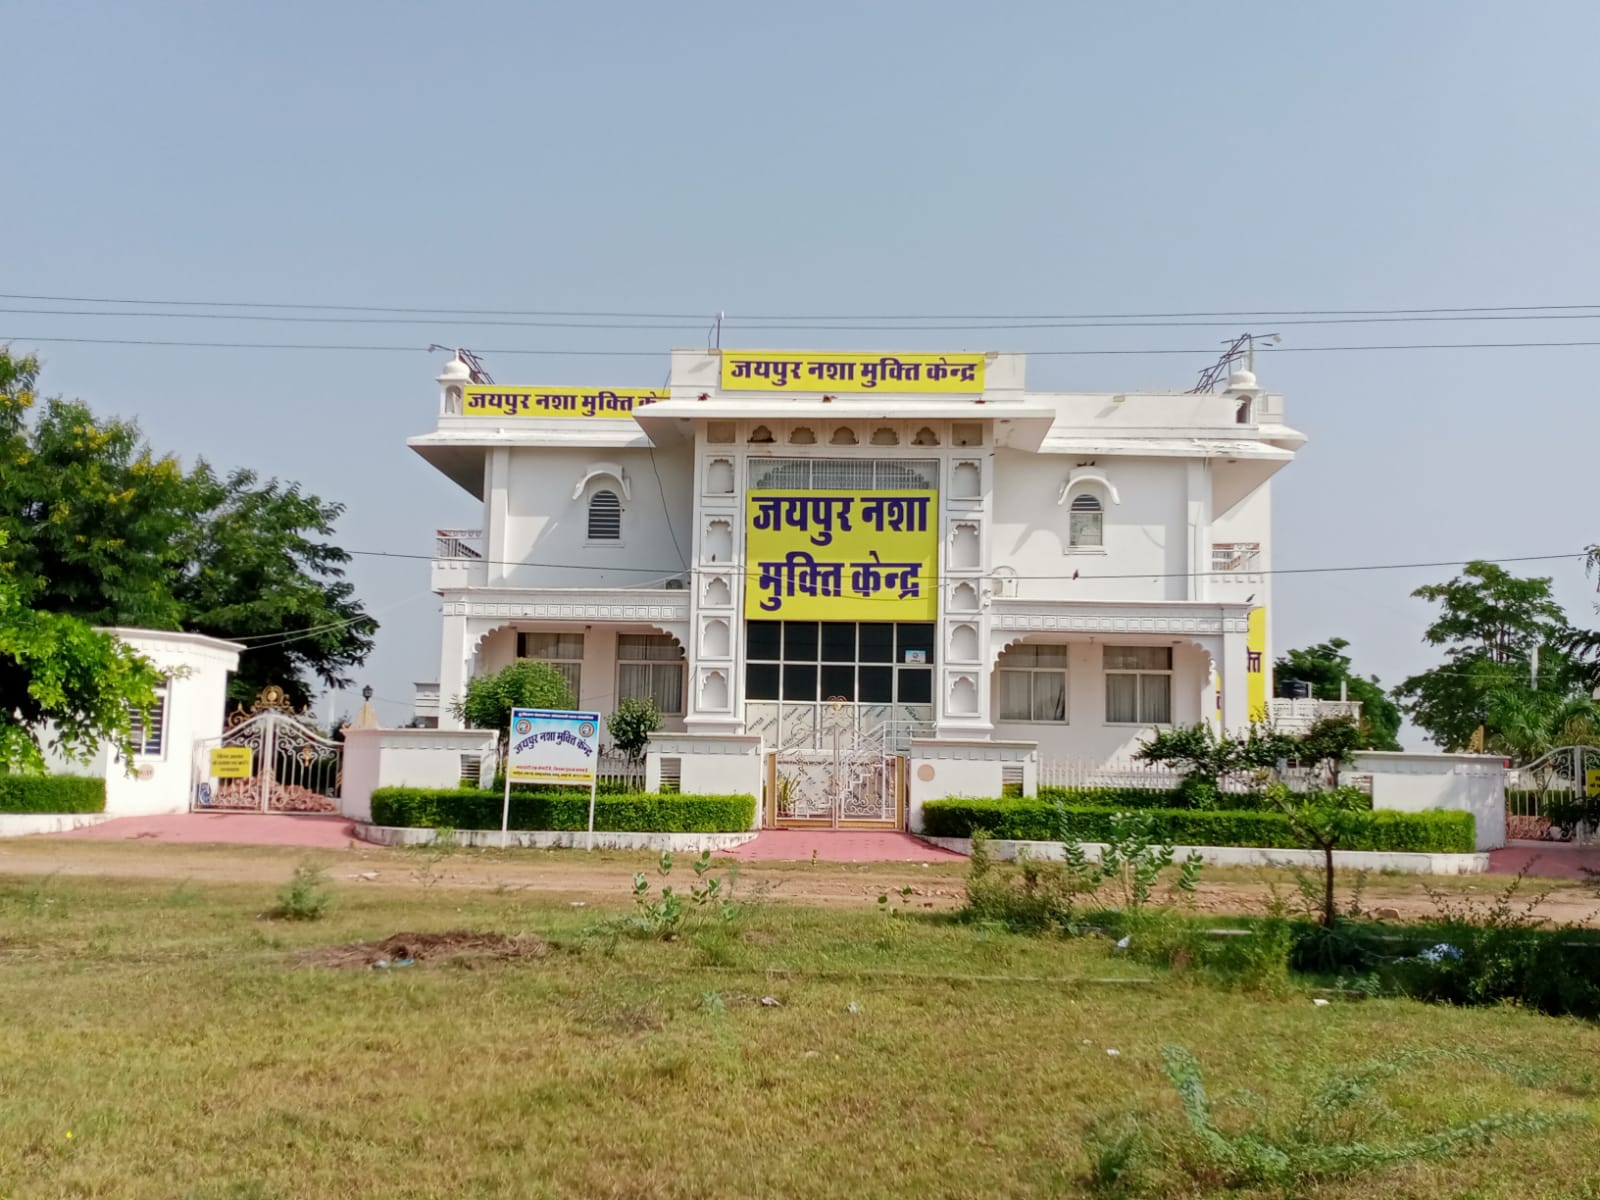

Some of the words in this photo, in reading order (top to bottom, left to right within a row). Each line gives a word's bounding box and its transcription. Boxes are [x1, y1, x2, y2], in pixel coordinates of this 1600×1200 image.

[729, 360, 802, 387] जयपुर
[808, 361, 856, 380] नशा
[860, 357, 921, 387] मुक्ति
[926, 357, 976, 382] केन्द्र
[468, 393, 531, 415] जयपुर
[535, 394, 577, 410] नशा
[582, 390, 635, 416] मुक्ति
[752, 496, 855, 547] जयपुर
[860, 496, 931, 532] नशा
[758, 551, 845, 611] मुक्ति
[850, 550, 922, 599] केन्द्र
[513, 733, 538, 755] जयपुर
[539, 731, 556, 742] नशा
